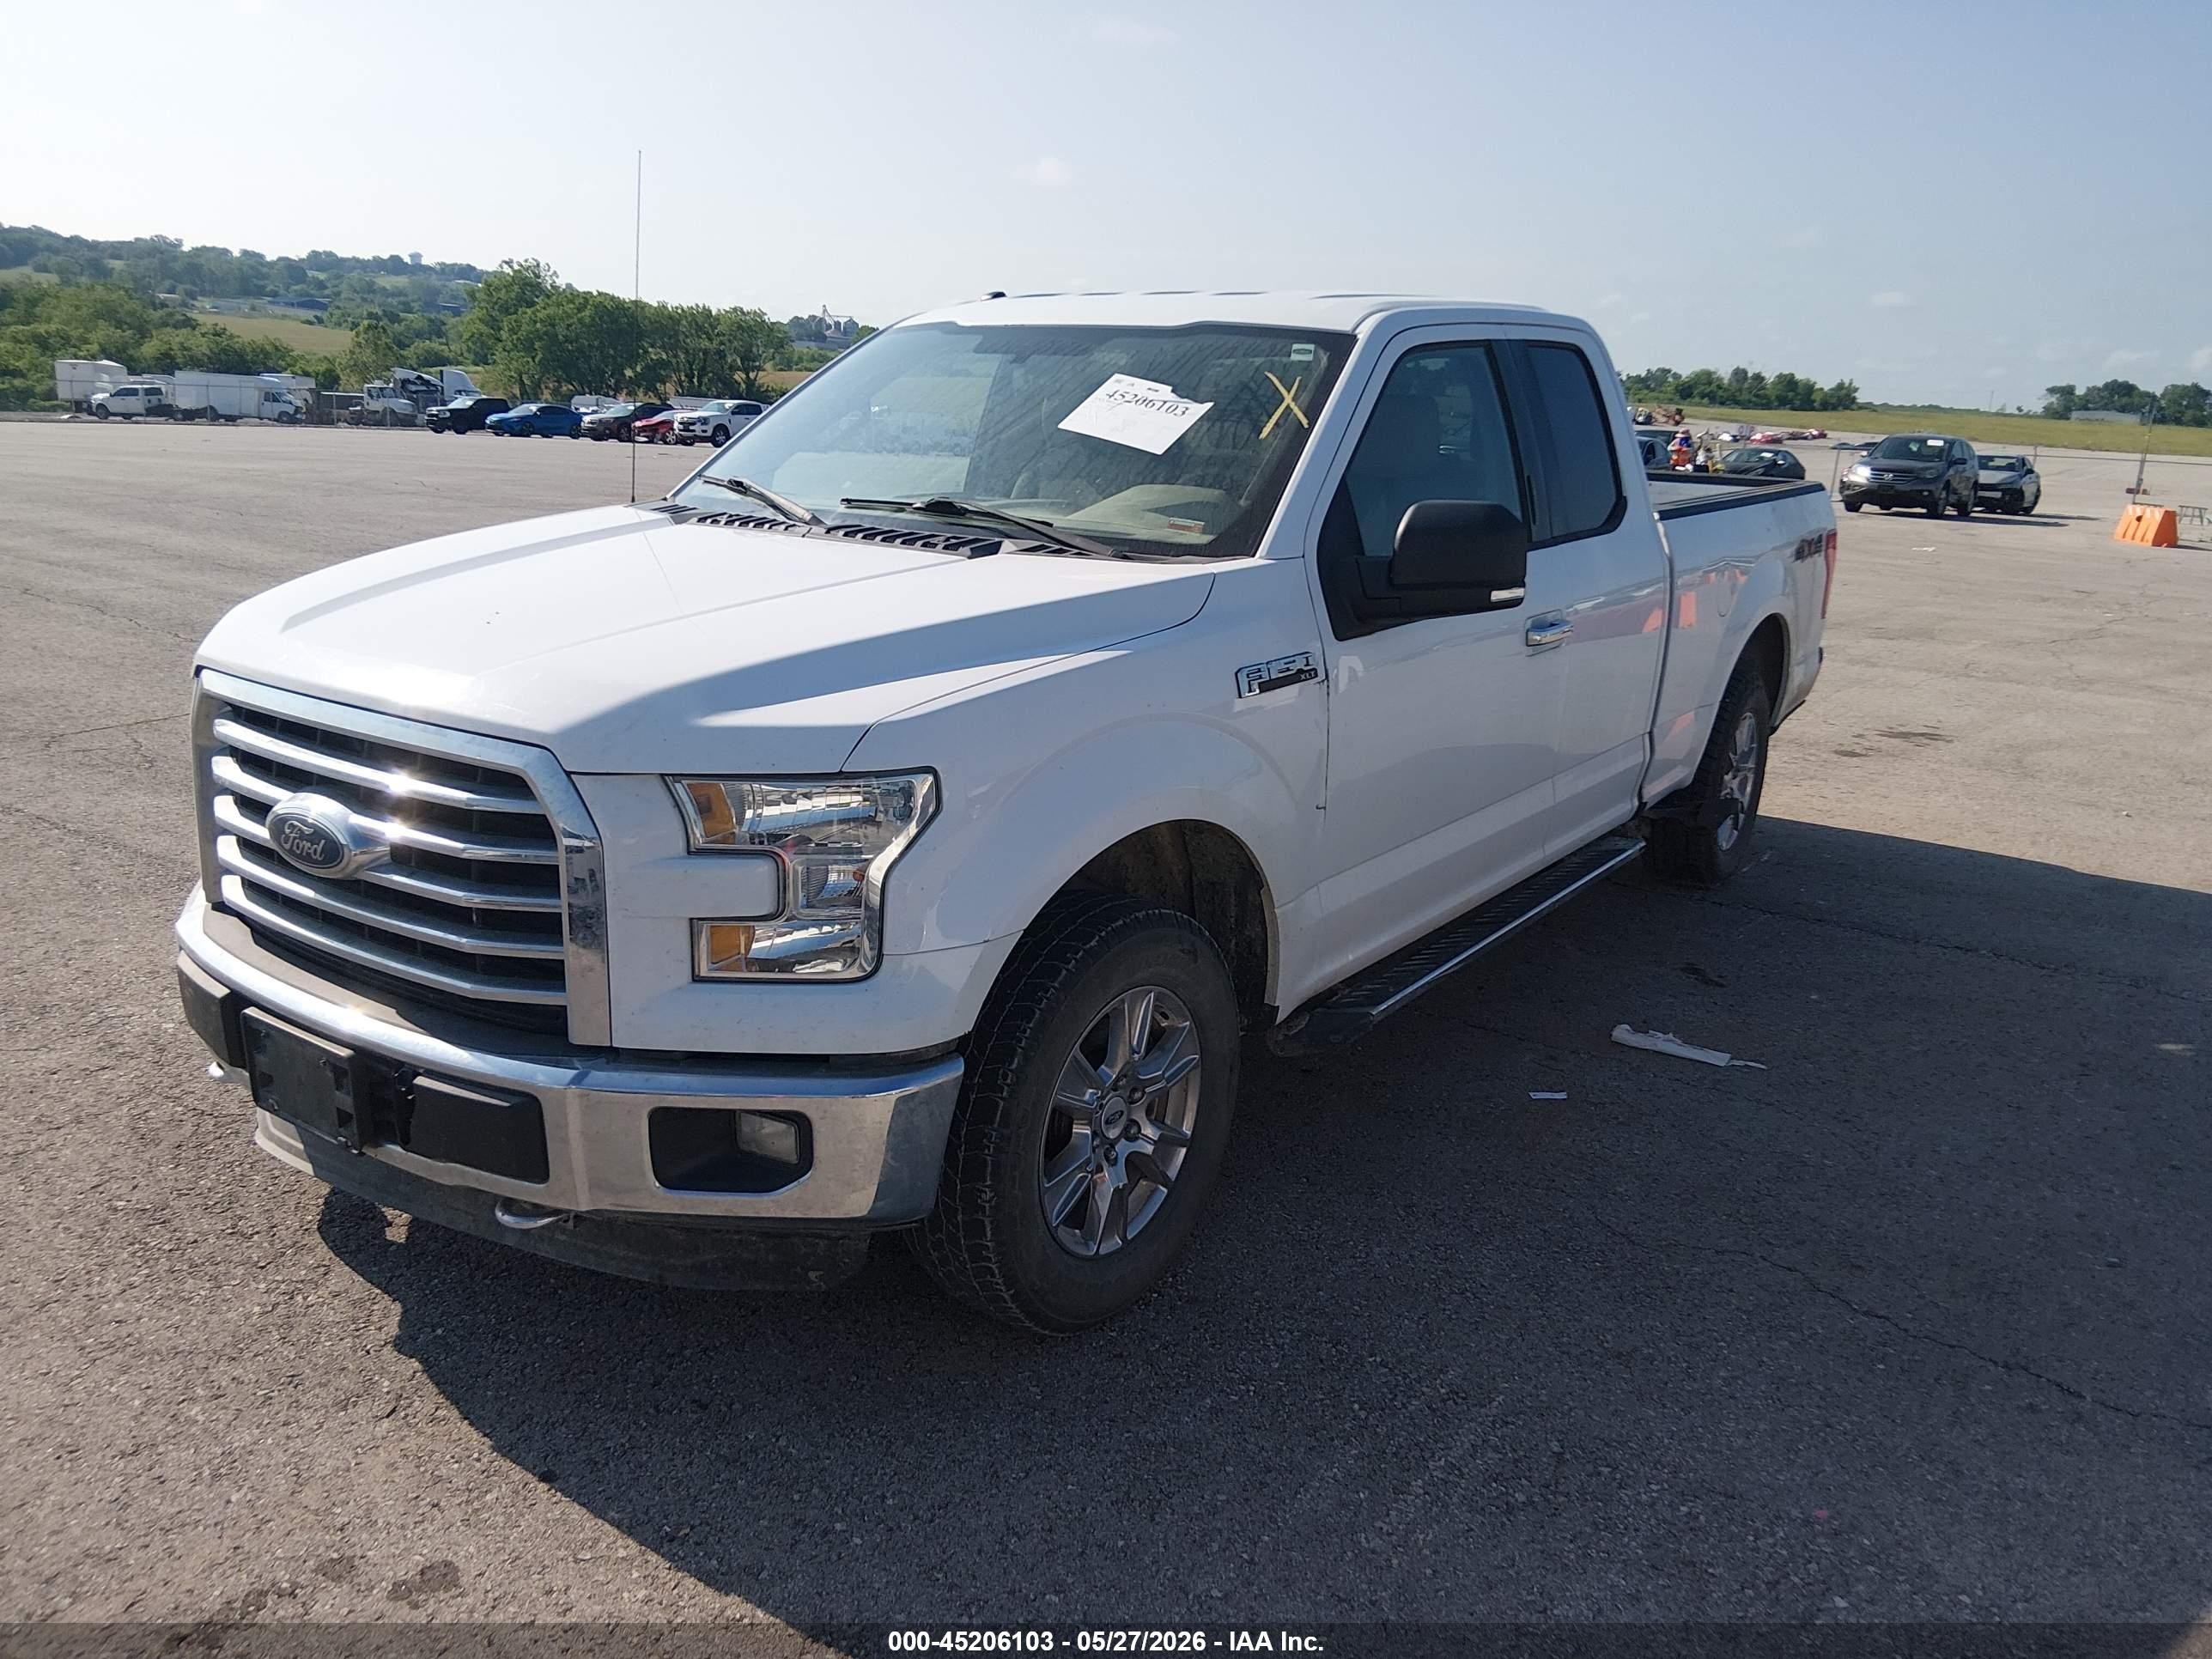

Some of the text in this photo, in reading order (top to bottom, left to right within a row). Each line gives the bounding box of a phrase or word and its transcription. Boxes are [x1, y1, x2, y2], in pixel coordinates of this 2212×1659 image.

[1106, 390, 1190, 417] 45206103
[1299, 671, 1316, 681] XLT
[281, 820, 325, 860] Ford
